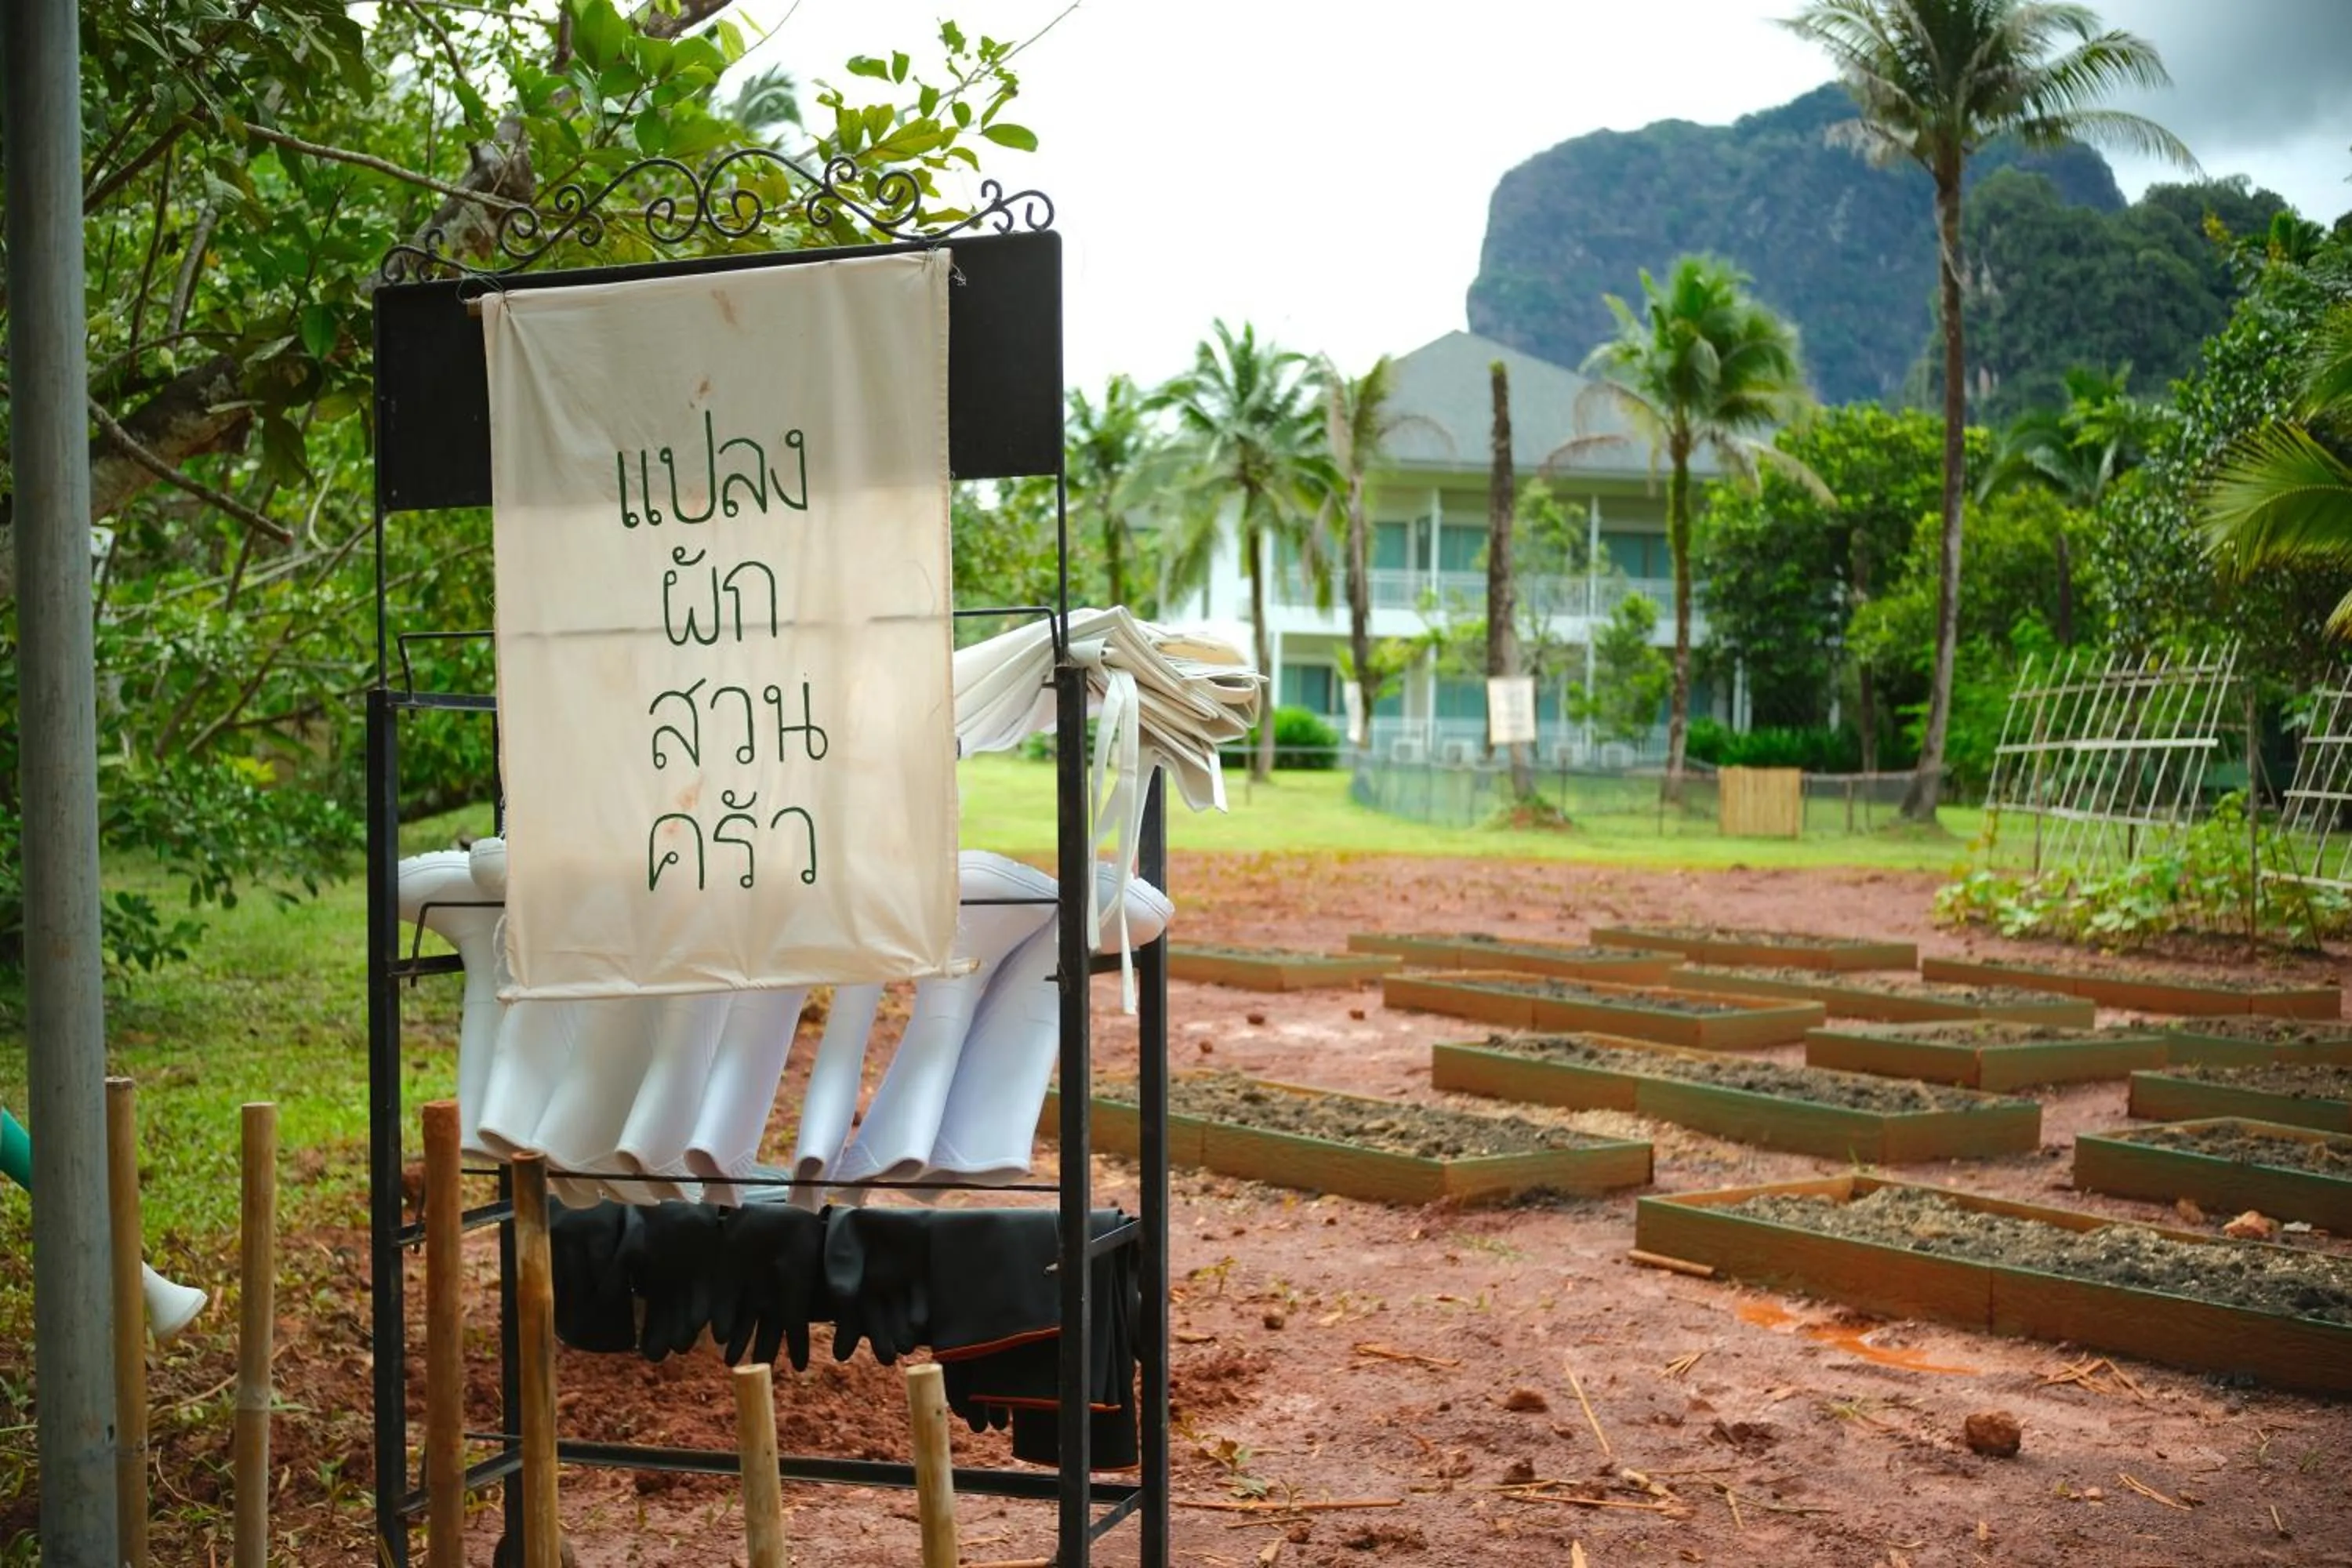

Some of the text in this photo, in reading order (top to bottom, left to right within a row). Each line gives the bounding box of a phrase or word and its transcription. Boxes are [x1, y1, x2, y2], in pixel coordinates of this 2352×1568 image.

[616, 408, 808, 529] แปลง
[662, 546, 778, 647] ผัก
[648, 677, 829, 771] สวน
[648, 789, 817, 892] ครัว
